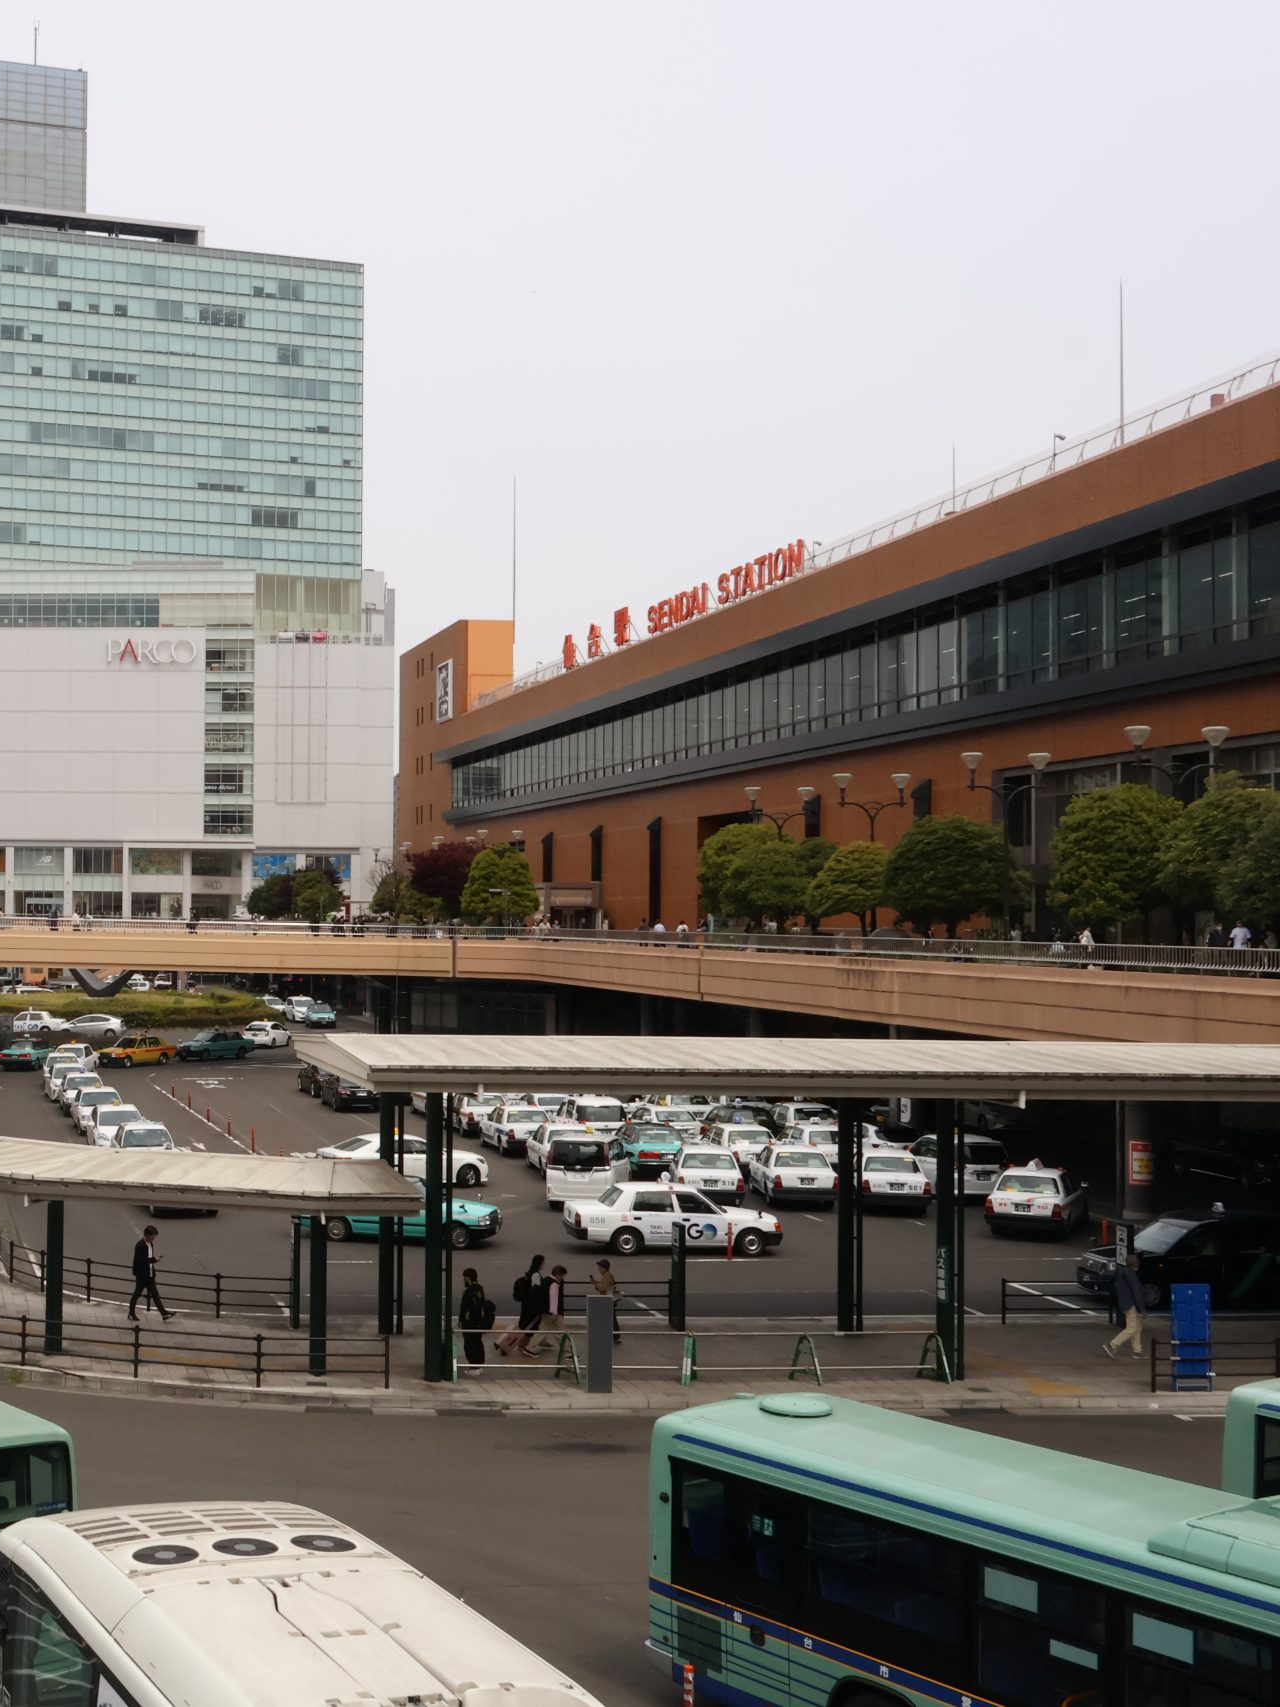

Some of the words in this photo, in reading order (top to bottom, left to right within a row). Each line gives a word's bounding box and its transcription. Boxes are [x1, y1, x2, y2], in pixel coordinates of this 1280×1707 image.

[647, 582, 708, 634] SENDAI
[717, 539, 805, 605] STATION
[106, 637, 198, 665] PARCO
